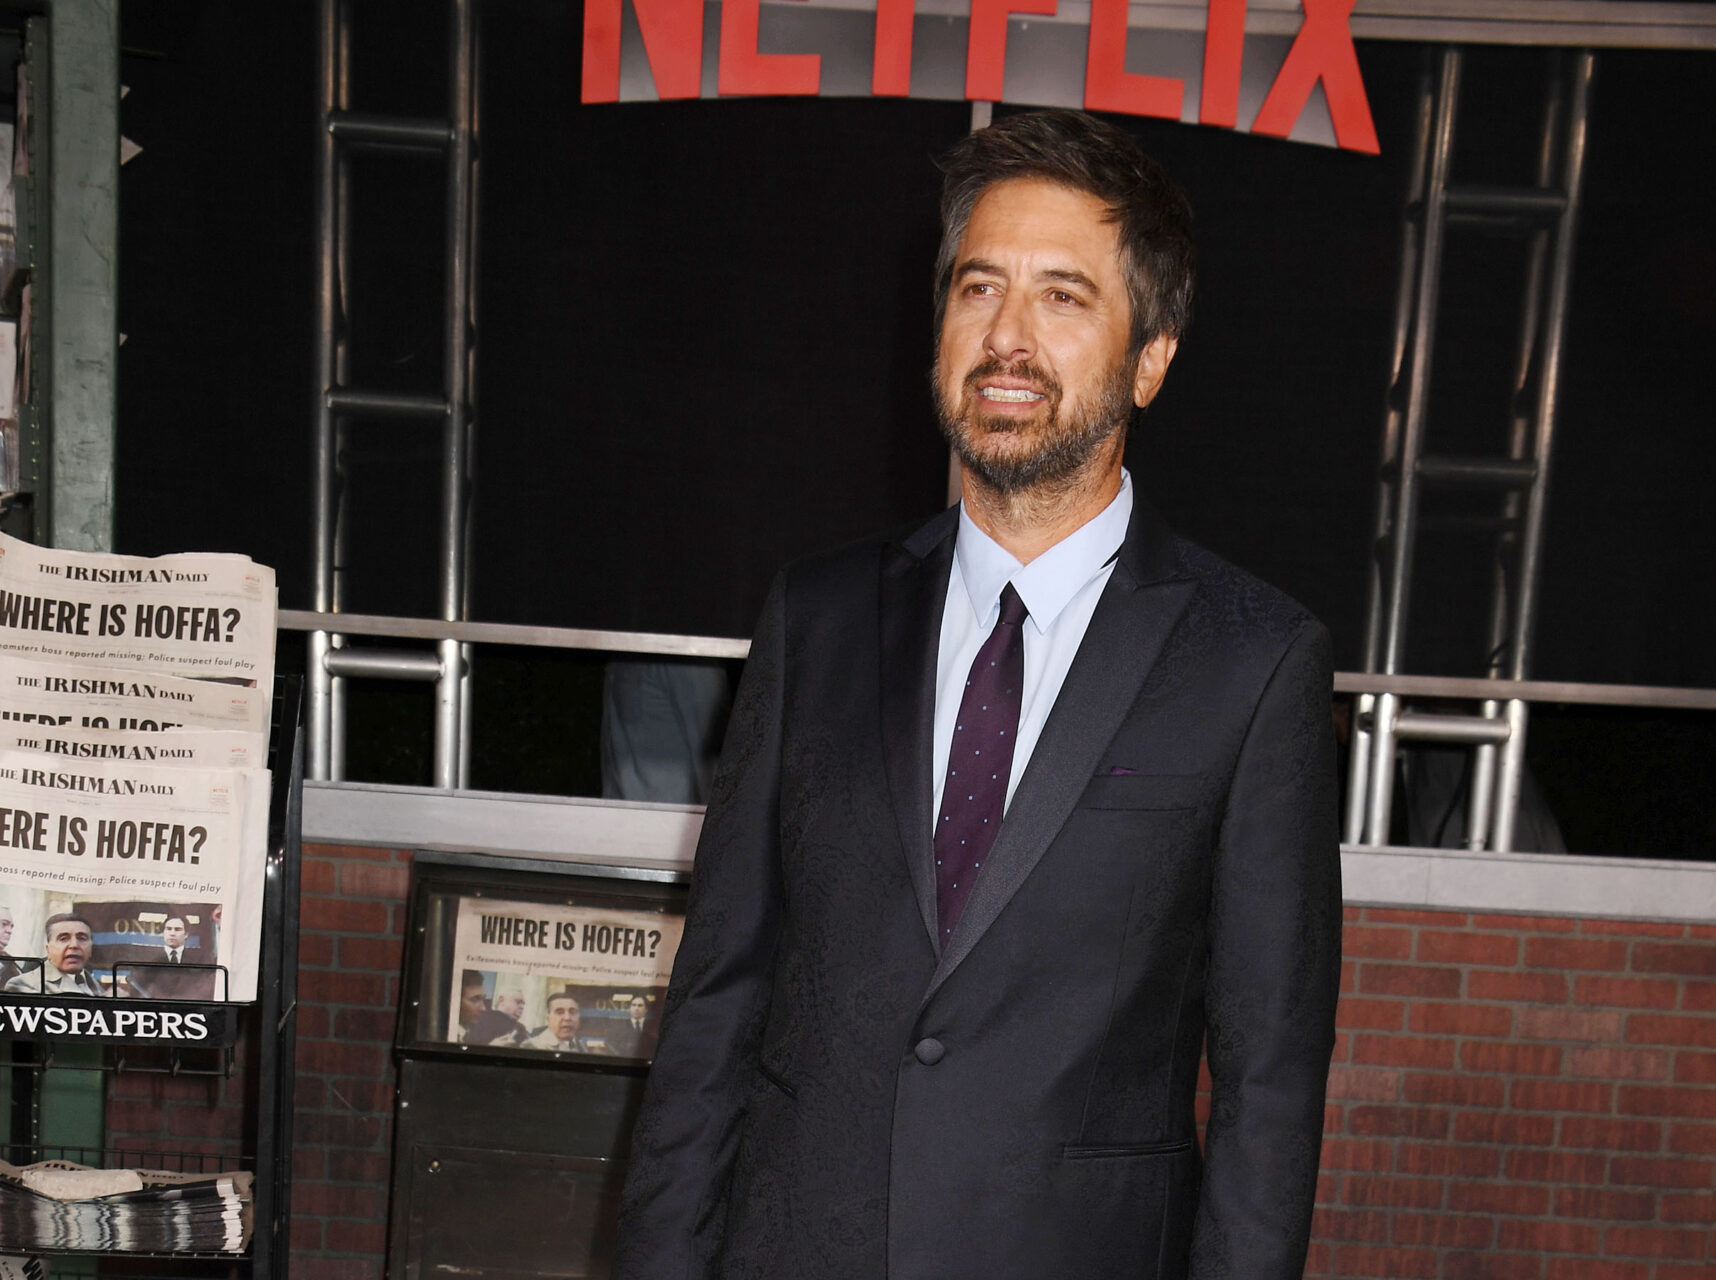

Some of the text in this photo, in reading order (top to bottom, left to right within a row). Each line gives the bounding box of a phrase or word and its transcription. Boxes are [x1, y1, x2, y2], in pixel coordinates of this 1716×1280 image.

[38, 564, 210, 583] THE IRISHMAN DAILY
[0, 589, 241, 643] WHERE IS HOFFA?
[41, 645, 62, 655] boss
[65, 649, 106, 658] reported
[148, 653, 175, 662] Police
[178, 657, 212, 665] suspect
[214, 657, 232, 666] foul
[235, 660, 256, 671] play
[17, 676, 195, 702] THE IRISHMAN DAILY
[17, 738, 195, 760] THE IRISHMAN DAILY
[21, 768, 136, 795] IRISHMAN
[139, 783, 176, 795] DAILY
[57, 815, 88, 856] IS
[96, 820, 208, 865] HOFFA?
[22, 868, 65, 880] reported
[110, 876, 137, 885] Police
[140, 879, 176, 888] suspect
[179, 880, 198, 890] foul
[200, 883, 221, 894] play
[481, 915, 661, 958] WHERE IS HOFFA?
